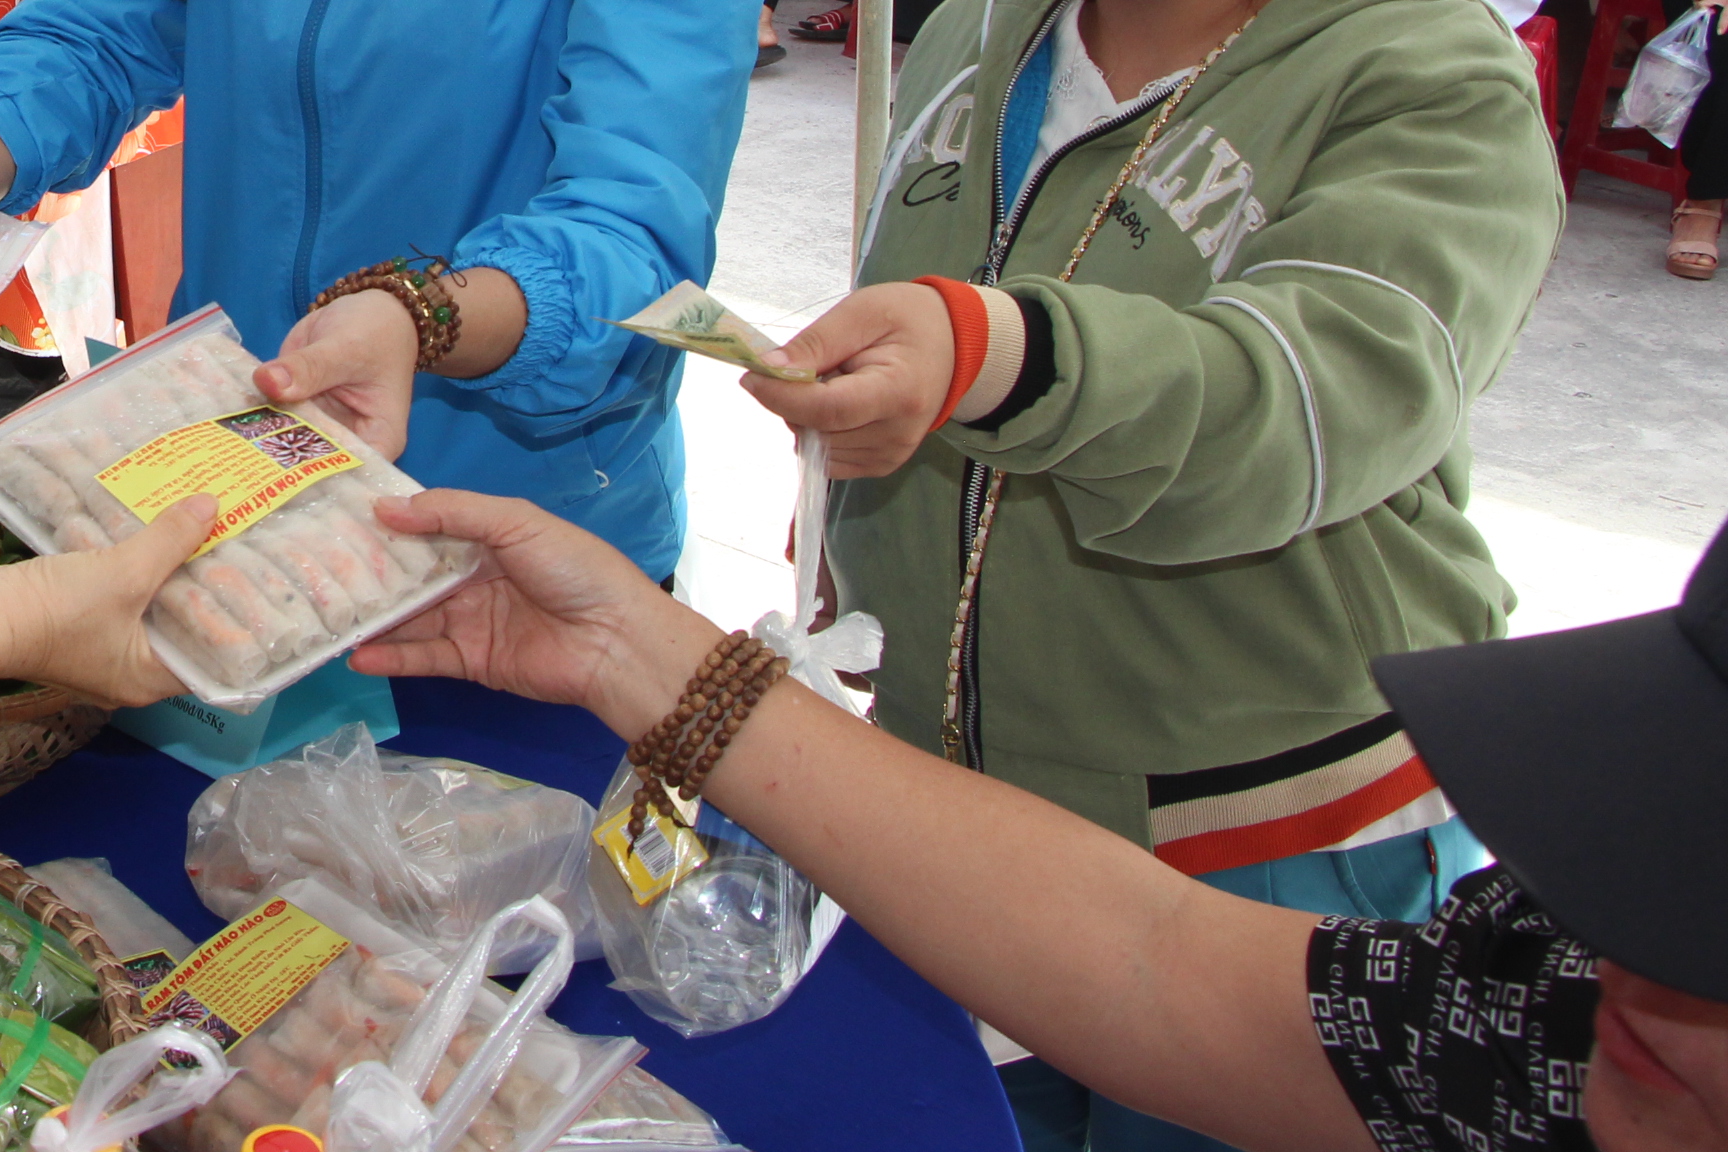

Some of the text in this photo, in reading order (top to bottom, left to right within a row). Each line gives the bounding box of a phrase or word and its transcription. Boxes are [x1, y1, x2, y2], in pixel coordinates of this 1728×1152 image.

[300, 461, 327, 475] RAM
[325, 453, 350, 465] CHẢ
[273, 471, 302, 491] TÔM
[252, 486, 277, 508] ĐẤT
[226, 502, 253, 525] HẢO
[146, 914, 263, 1009] RAM TÔM ĐẤT HẢO HẢO
